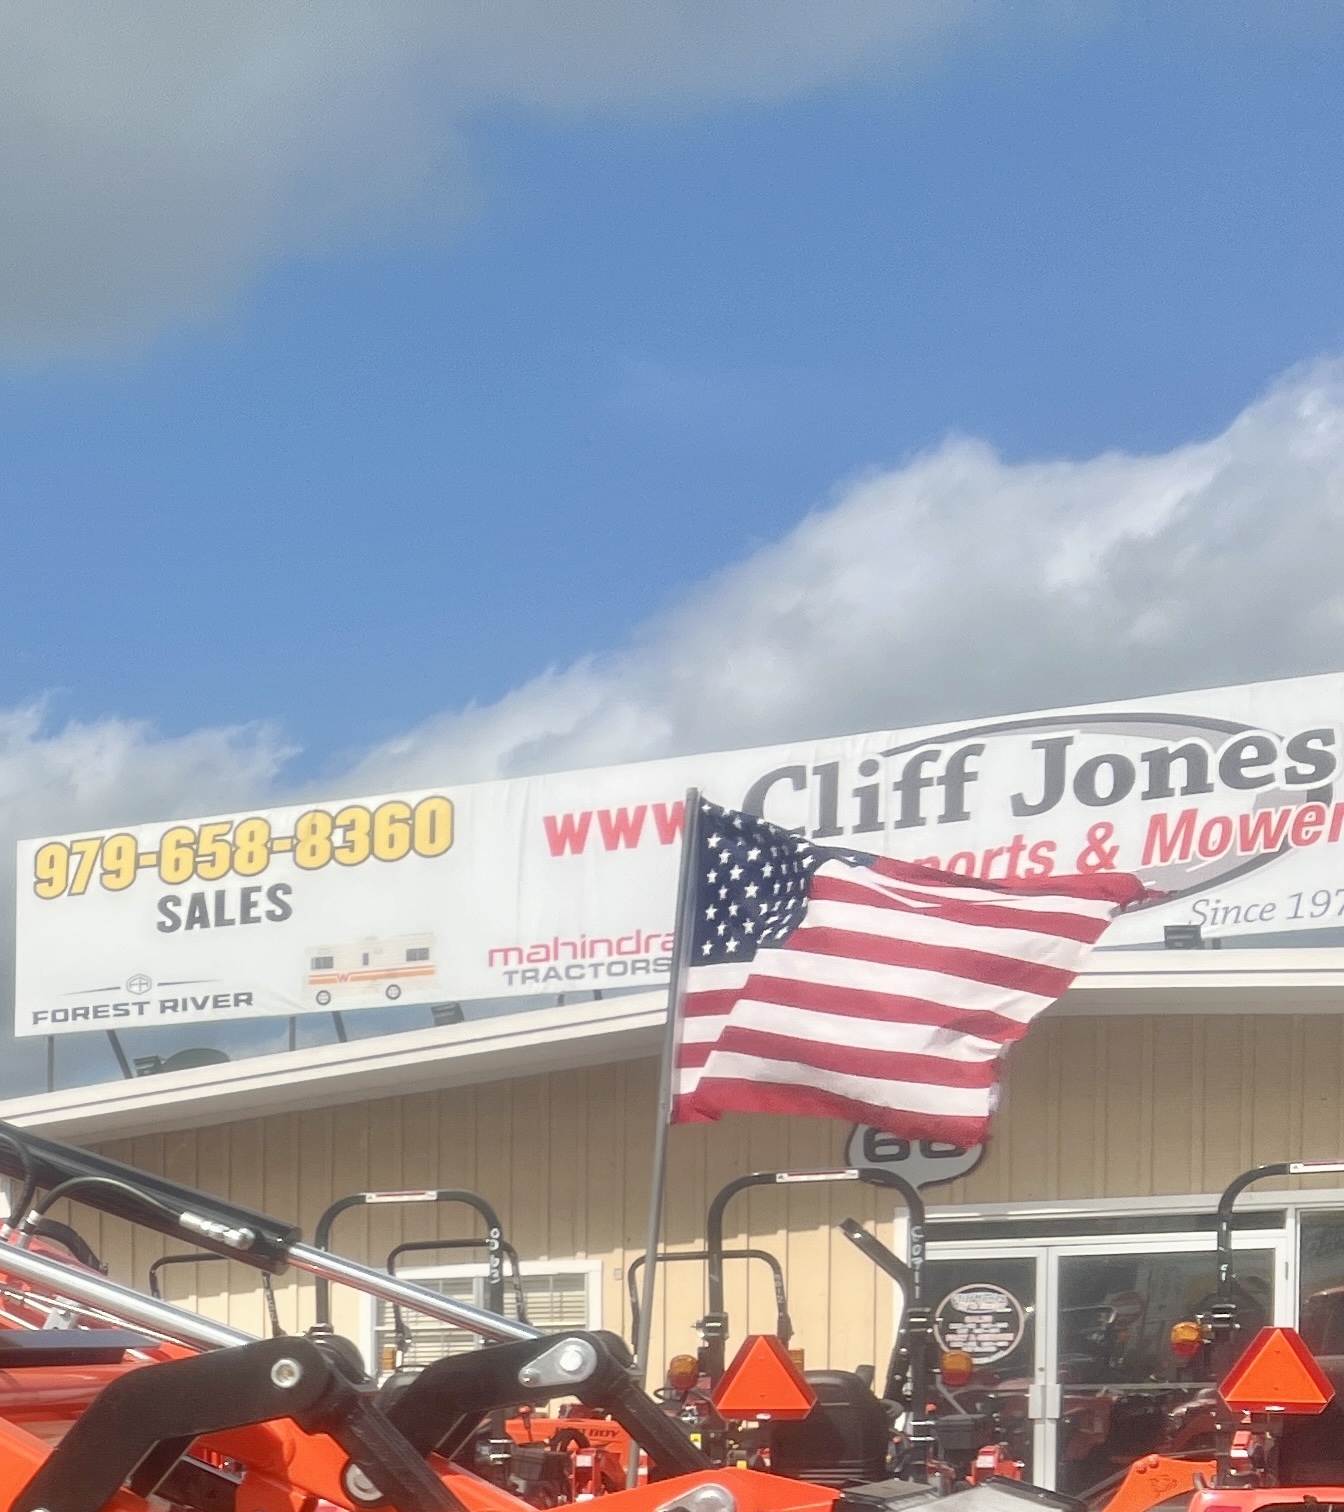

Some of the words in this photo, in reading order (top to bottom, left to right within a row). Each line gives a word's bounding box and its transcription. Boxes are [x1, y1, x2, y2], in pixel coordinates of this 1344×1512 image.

[742, 744, 987, 838] Cliff
[1010, 728, 1337, 818] Jones
[33, 795, 454, 900] 979-658-8360
[1076, 822, 1120, 875] &
[156, 882, 294, 934] SALES
[1191, 897, 1276, 927] Since
[503, 957, 673, 987] TRACTORS
[32, 998, 151, 1026] FOREST
[159, 991, 253, 1016] RIVER
